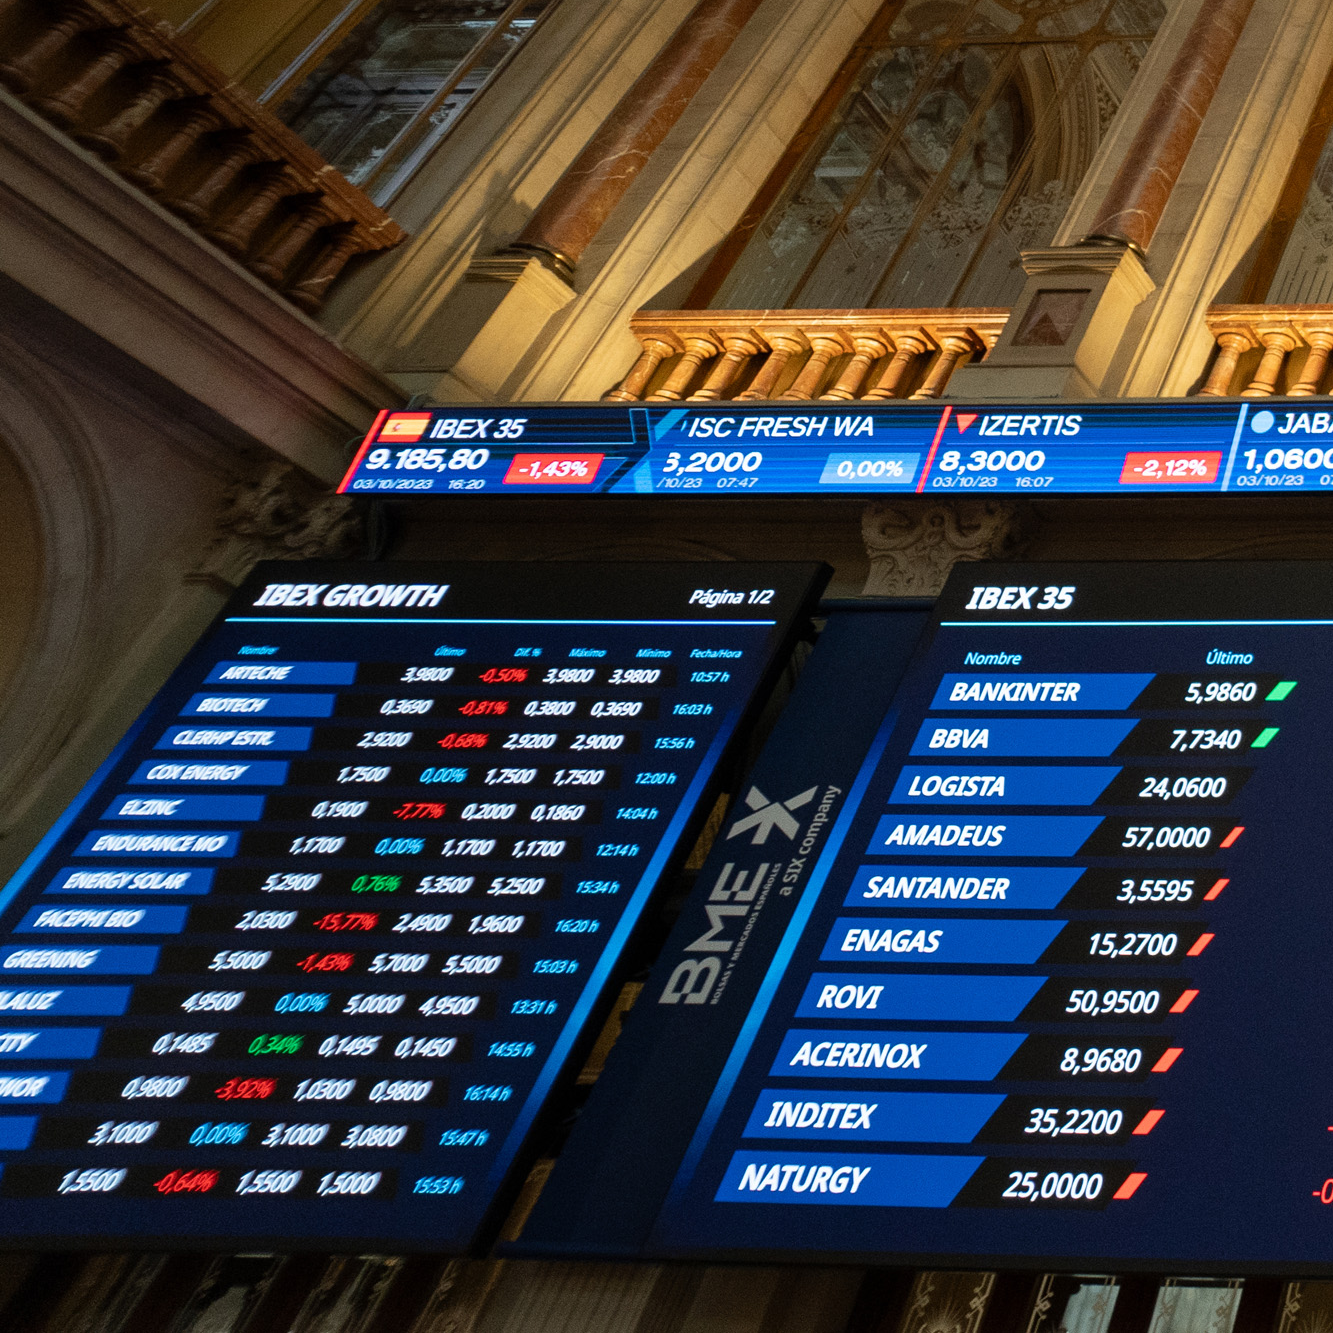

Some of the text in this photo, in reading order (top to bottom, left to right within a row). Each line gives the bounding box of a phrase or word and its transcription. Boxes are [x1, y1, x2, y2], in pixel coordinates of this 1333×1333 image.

[429, 418, 528, 439] IBEX 35
[688, 417, 874, 438] ISC FRESH WA
[978, 415, 1082, 436] IZERTIS
[365, 449, 589, 478] 9.185,80 -1,43%
[939, 450, 1208, 477] 8,3000 -2,12%
[932, 477, 1053, 488] 03/10/23 16:07
[254, 585, 449, 607] IBEX GROWTH
[689, 589, 776, 607] Página 1/2
[964, 586, 1076, 610] IBEX 35
[964, 648, 1254, 666] Nombre Último
[218, 666, 295, 680] ARTECHE
[543, 668, 596, 685] 3,9800
[195, 697, 270, 712] BIOTECH
[949, 682, 1080, 702] BANKINTER
[1184, 682, 1258, 705] 5,9860
[928, 729, 1243, 752] BBVA 7,7340
[146, 764, 251, 780] COX ENERGY
[908, 776, 1005, 797] LOGISTA
[1138, 777, 1227, 800] 24,0600
[884, 825, 1006, 846] AMADEUS
[1121, 827, 1211, 851] 57,0000
[863, 876, 1195, 903] SANTANDER 3,5595
[658, 862, 771, 1005] BME
[840, 929, 943, 953] ENAGAS
[1090, 933, 1178, 958] 15,2700
[816, 985, 1161, 1016] ROVI 50,9500
[789, 1042, 927, 1069] ACERINOX
[1059, 1047, 1142, 1074] 8,9680
[763, 1101, 1123, 1137] INDITEX 35,2200
[738, 1164, 871, 1194] NATURGY
[1002, 1172, 1104, 1202] 25,0000
